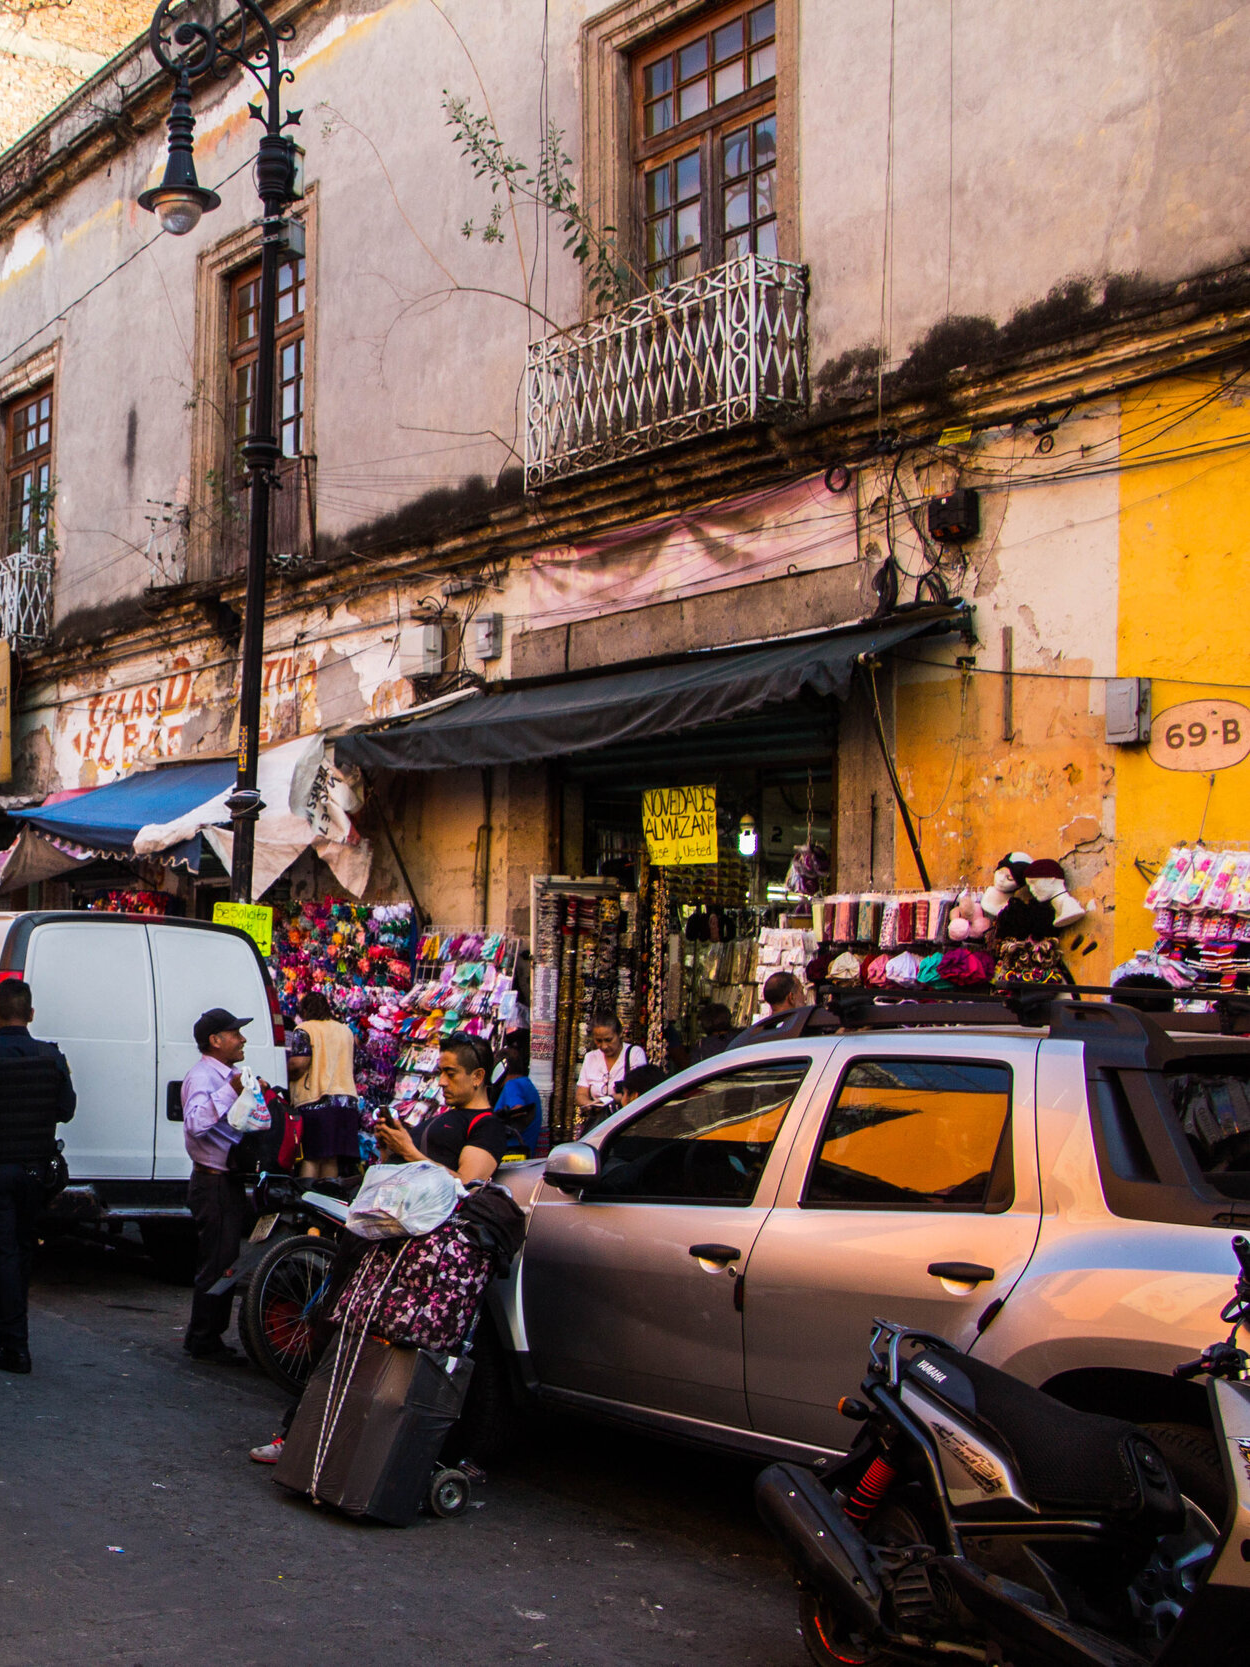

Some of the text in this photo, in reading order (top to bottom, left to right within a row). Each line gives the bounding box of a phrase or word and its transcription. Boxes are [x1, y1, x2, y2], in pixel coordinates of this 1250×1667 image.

[642, 785, 717, 818] NOVEDADES
[645, 814, 710, 841] ALMAZAN
[683, 841, 712, 857] Usted
[917, 1359, 948, 1384] YAMAHA
